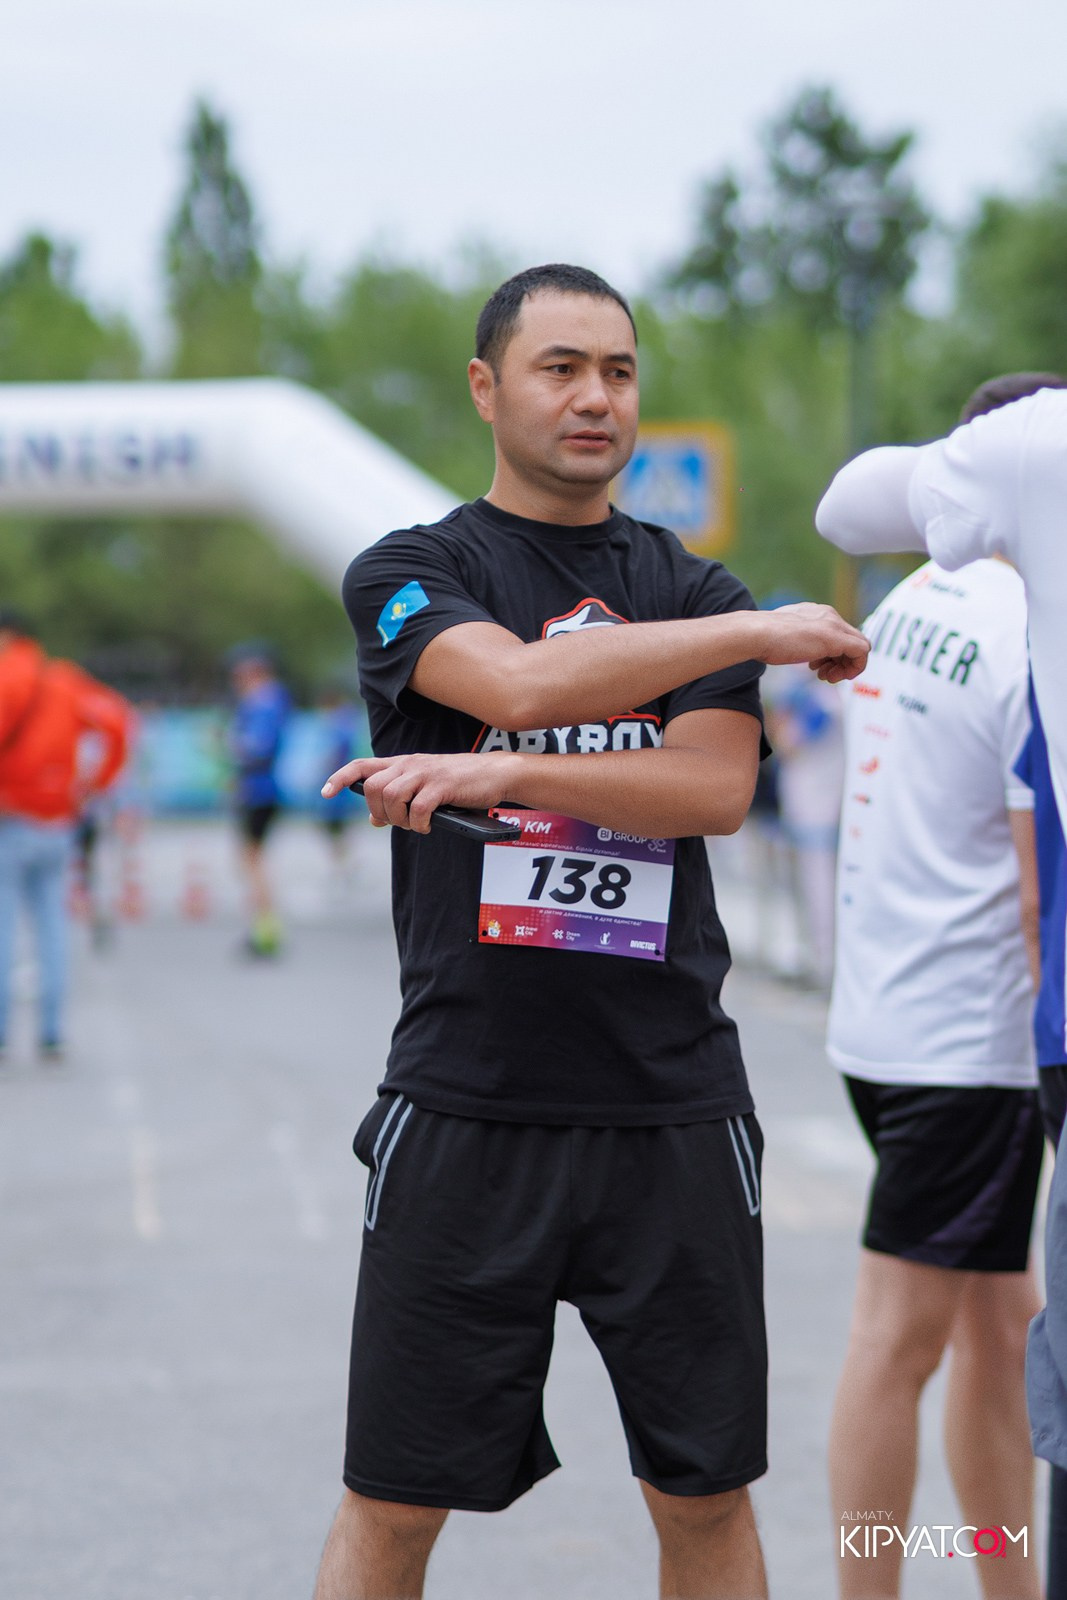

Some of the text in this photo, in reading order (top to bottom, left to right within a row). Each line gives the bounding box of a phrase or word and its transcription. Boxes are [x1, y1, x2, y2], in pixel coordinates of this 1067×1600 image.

[524, 821, 552, 834] KM
[614, 831, 647, 843] GROUP
[527, 855, 632, 910] 138
